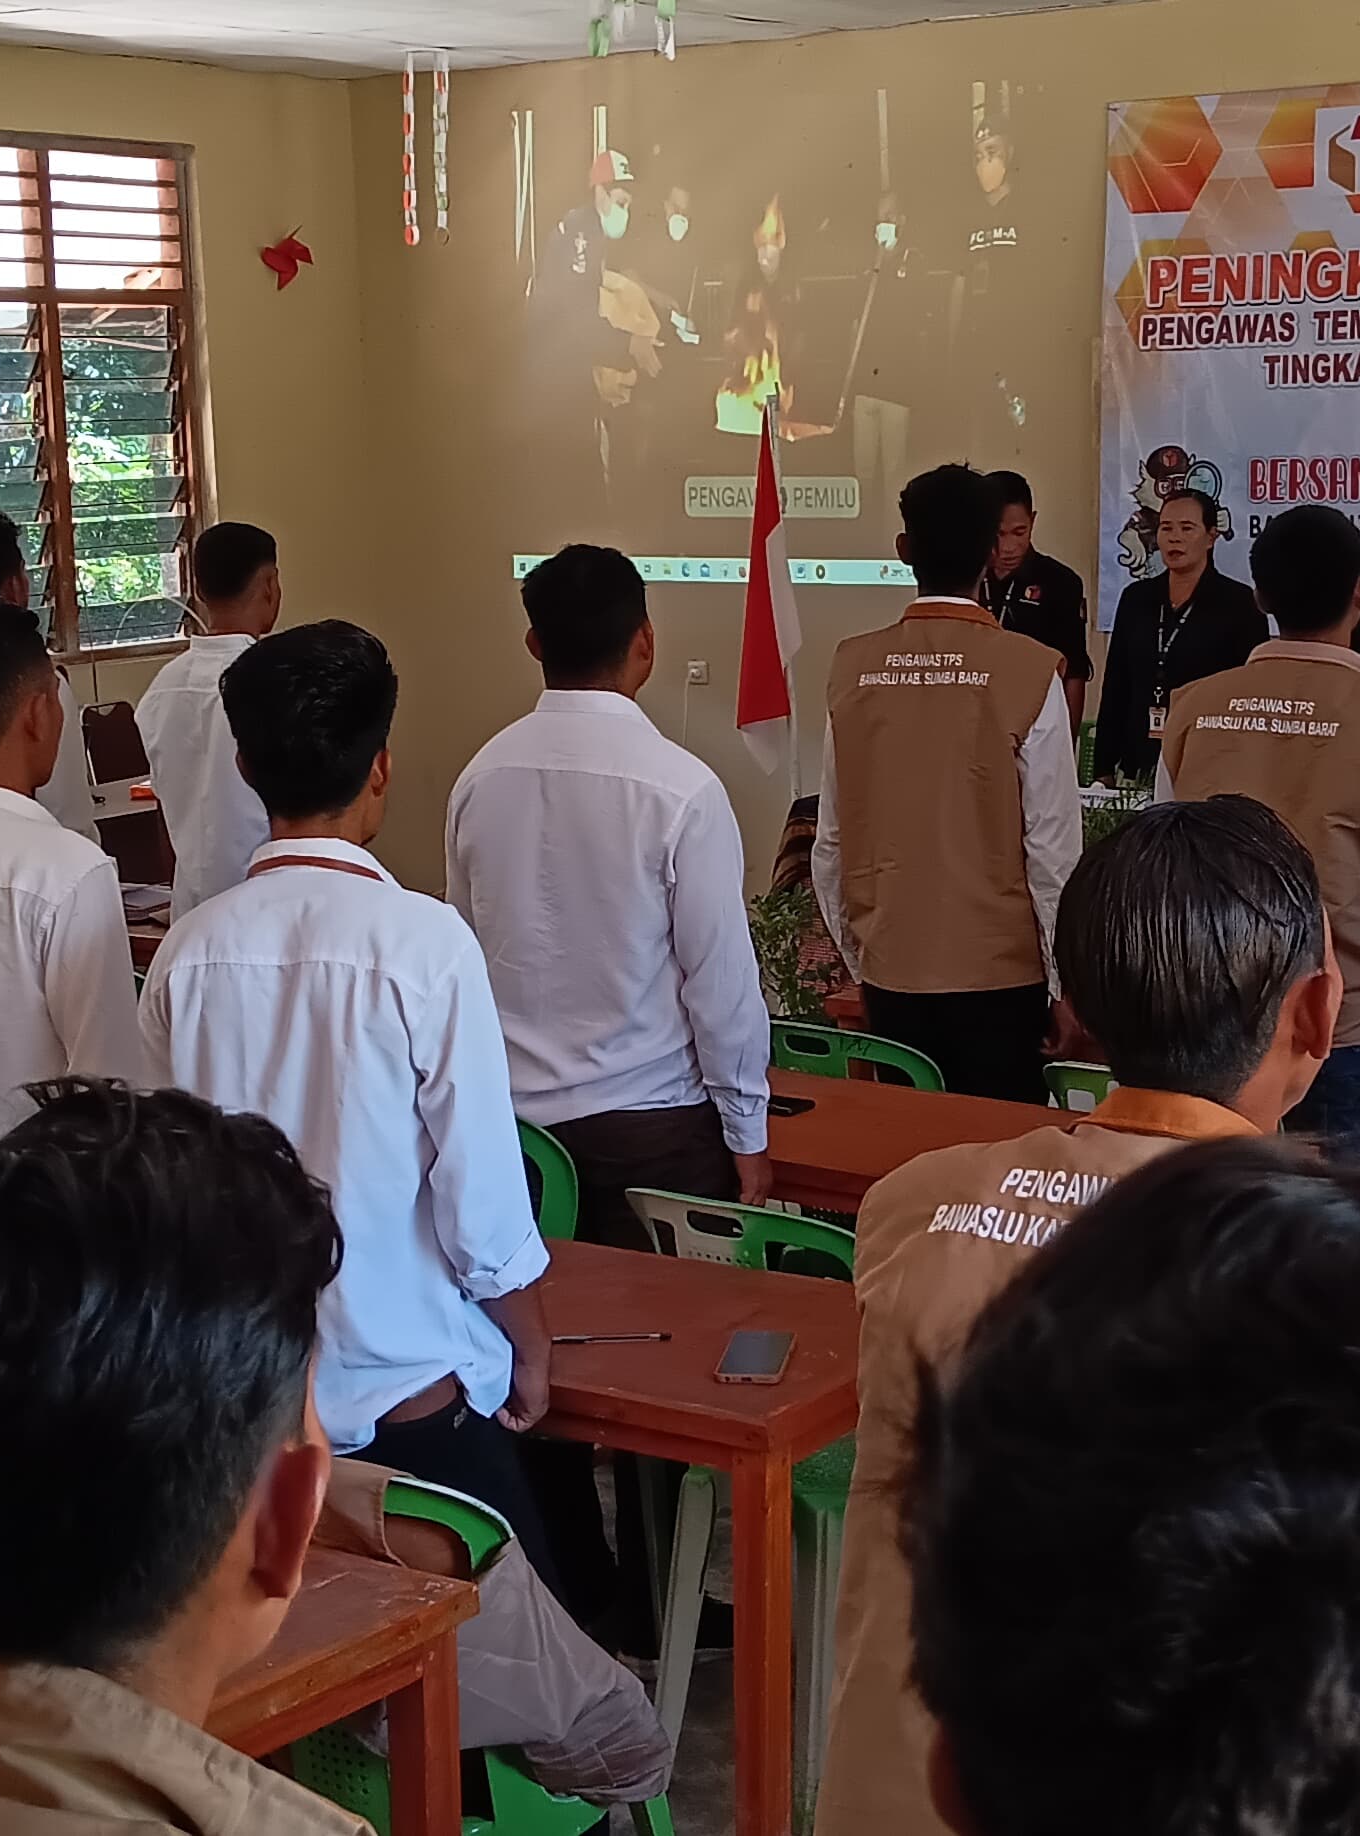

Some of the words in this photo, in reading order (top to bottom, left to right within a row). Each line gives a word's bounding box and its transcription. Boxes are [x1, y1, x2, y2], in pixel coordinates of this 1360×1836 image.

[1141, 312, 1295, 347] PENGAWAS
[792, 486, 857, 509] PEMILU
[885, 653, 941, 667] PENGAWAS
[942, 653, 965, 667] TPS
[957, 671, 990, 687] BARAT
[1228, 697, 1293, 714] PENGAWAS
[1293, 700, 1316, 716] TPS
[1242, 716, 1268, 732] KAB.
[1270, 719, 1307, 736] SUMBA
[1307, 722, 1340, 737] BARAT
[926, 1202, 1024, 1245] BAWASLU
